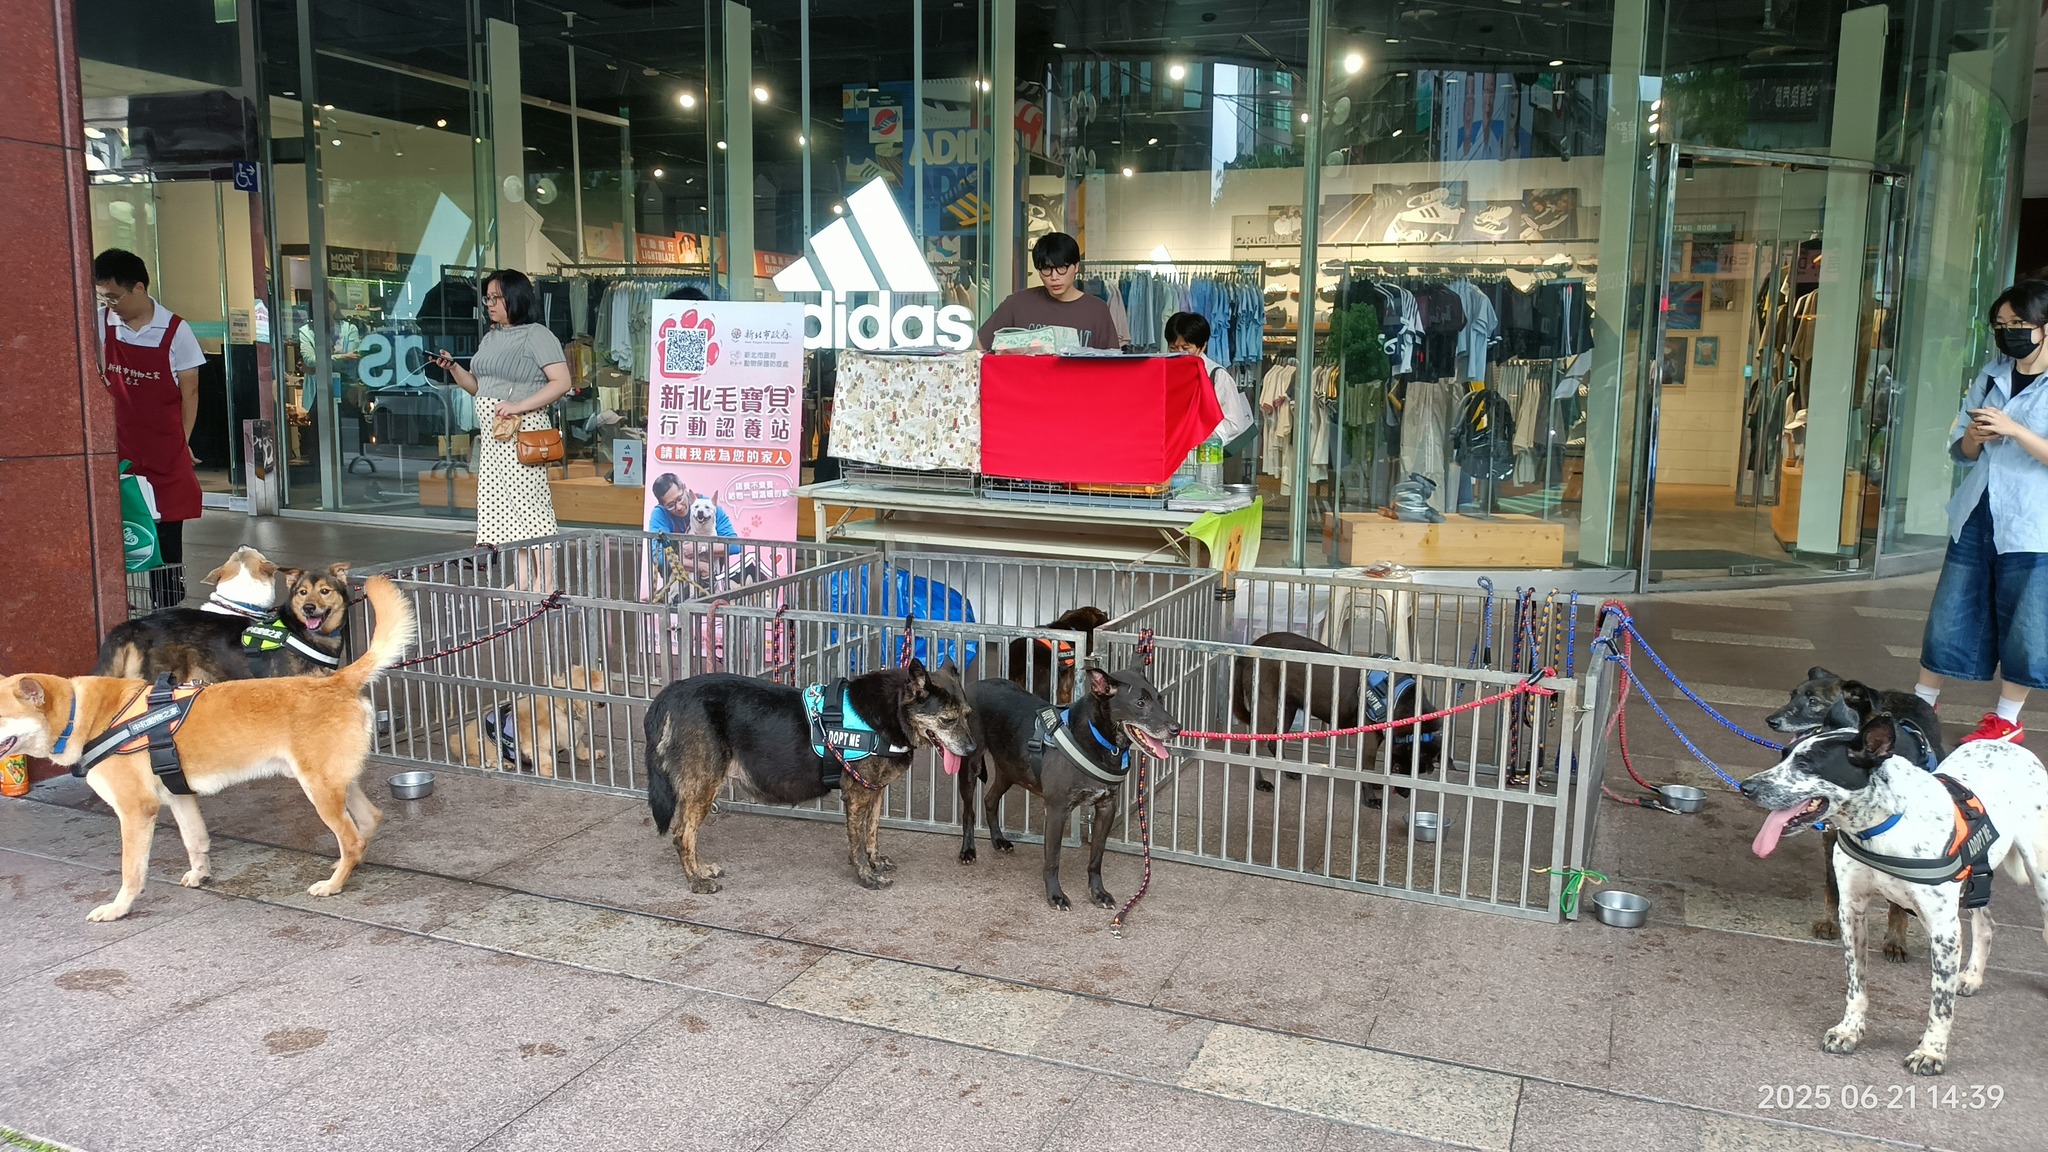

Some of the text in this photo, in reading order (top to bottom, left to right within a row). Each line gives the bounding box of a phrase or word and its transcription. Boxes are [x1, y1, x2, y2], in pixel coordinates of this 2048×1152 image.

[804, 290, 975, 351] didas
[660, 384, 796, 414] 新北毛寶貝
[660, 415, 790, 440] 行動認養站
[622, 456, 634, 475] 7
[660, 445, 788, 465] 請讓我成為您的家人
[827, 730, 861, 748] DOPT ME
